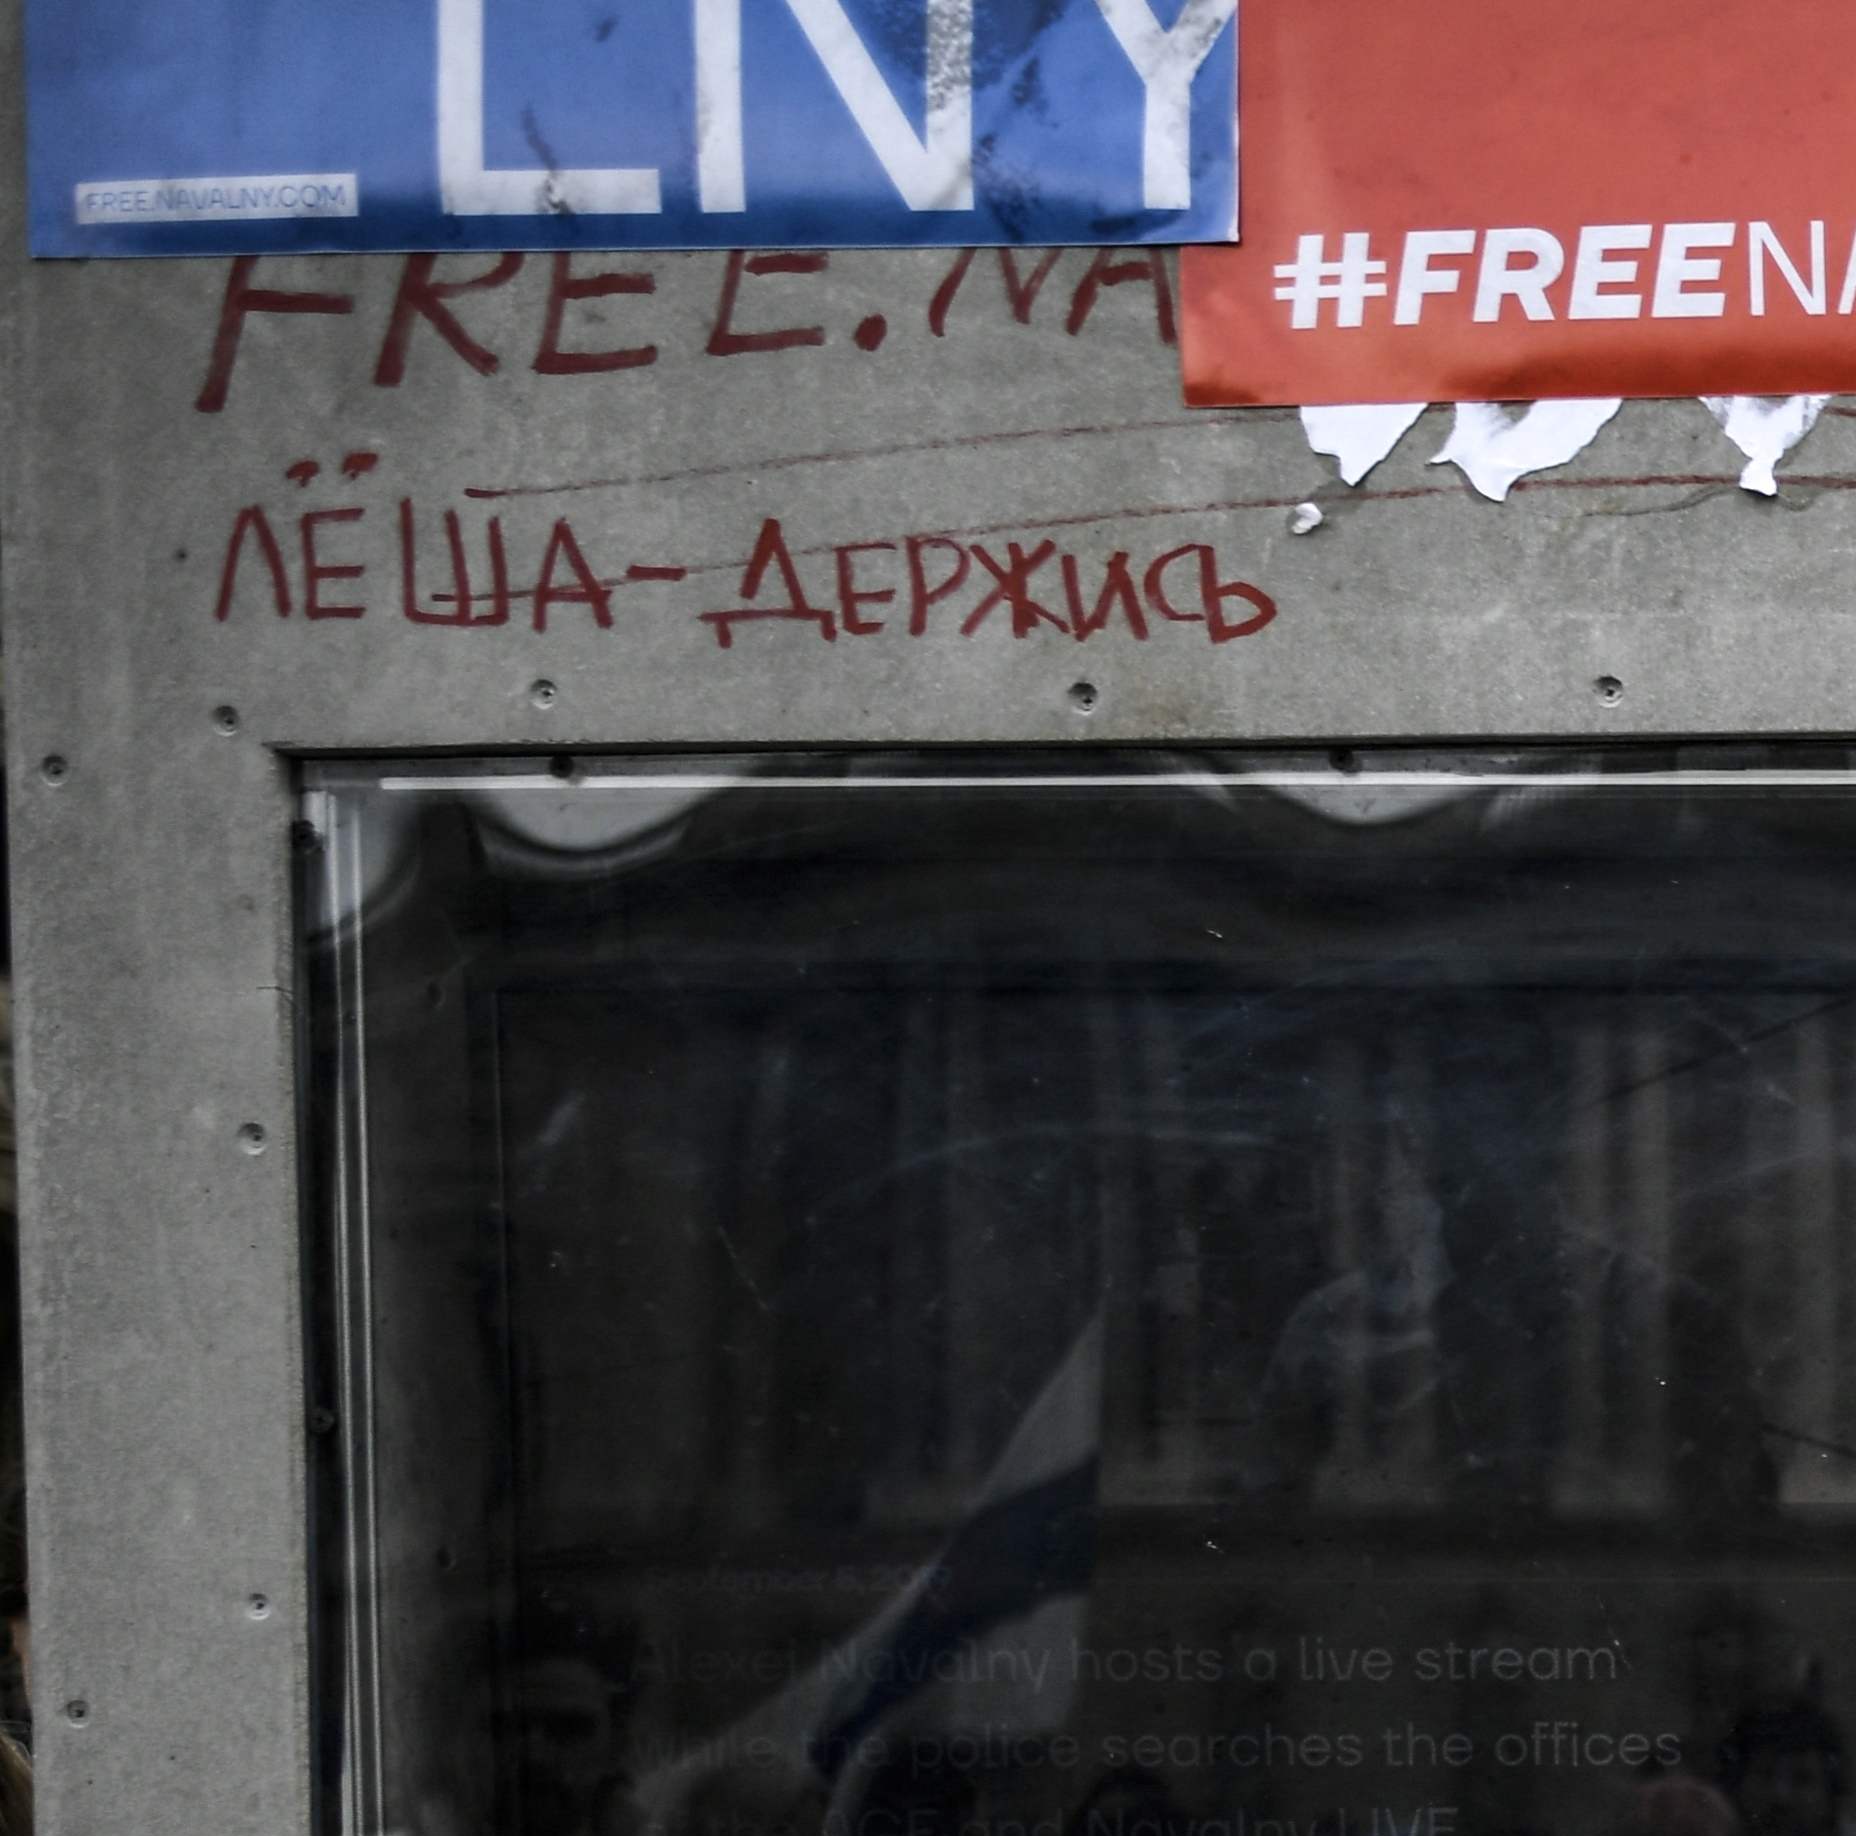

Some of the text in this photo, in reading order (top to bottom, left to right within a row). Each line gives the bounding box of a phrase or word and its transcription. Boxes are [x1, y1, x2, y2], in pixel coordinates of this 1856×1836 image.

[85, 183, 347, 213] FREE.NAVALNY.COM
[1071, 1636, 1222, 1683] hosts
[1243, 1647, 1278, 1683] a
[1298, 1634, 1393, 1683] live
[1413, 1641, 1619, 1683] stream
[911, 1724, 1081, 1778] police
[1099, 1722, 1364, 1768] searches
[1382, 1722, 1475, 1768] the
[1493, 1720, 1683, 1767] offices
